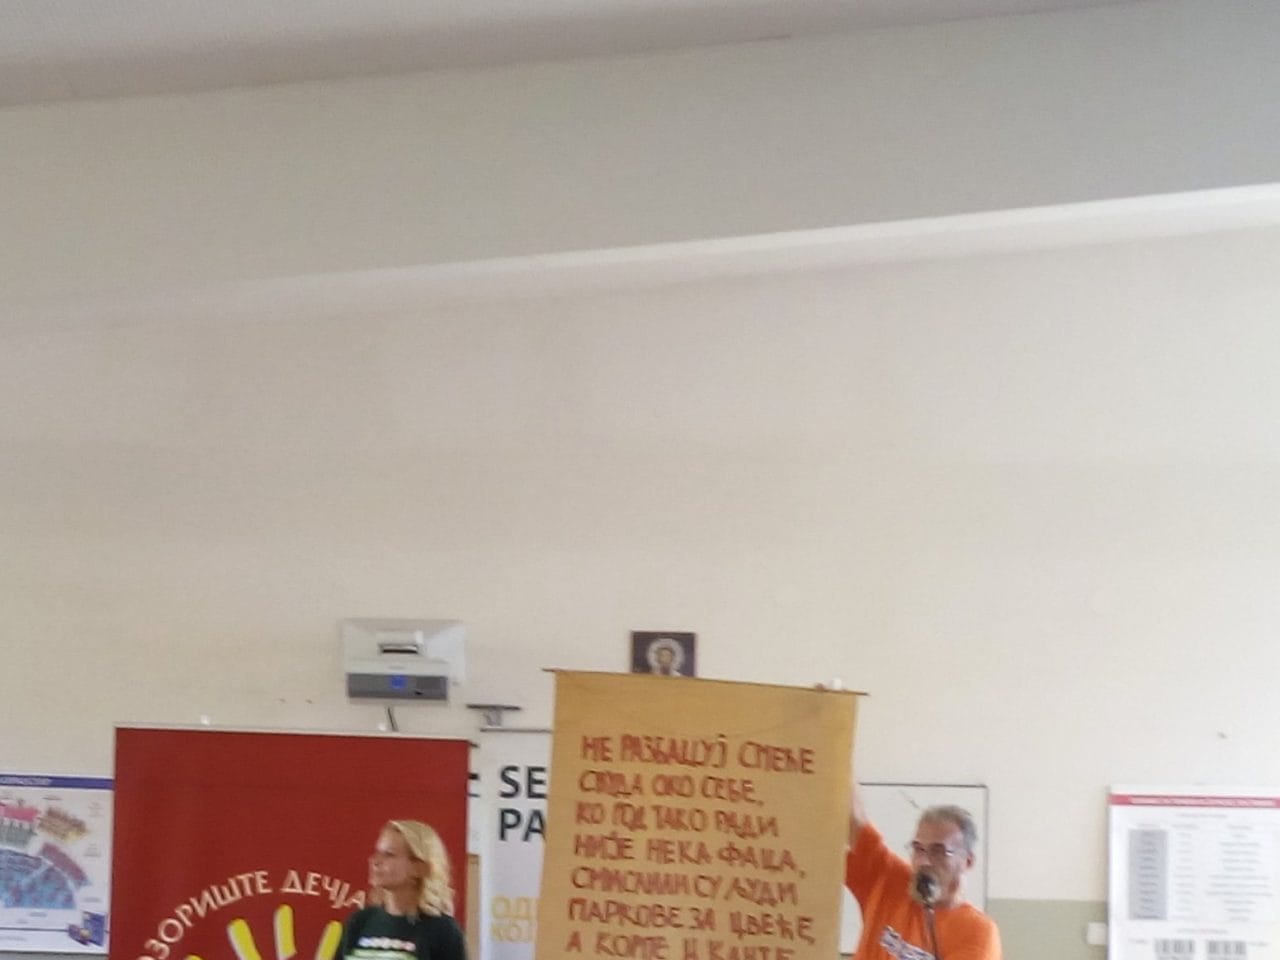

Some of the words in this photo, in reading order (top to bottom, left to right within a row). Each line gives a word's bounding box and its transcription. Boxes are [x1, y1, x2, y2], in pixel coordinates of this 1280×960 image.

[581, 735, 613, 763] НЕ
[498, 765, 548, 800] SE
[652, 774, 695, 798] ОКО
[497, 807, 547, 842] PA
[575, 802, 606, 825] КО
[612, 802, 648, 832] ГОД
[652, 804, 709, 833] ТАКО
[714, 810, 780, 839] РАДИ
[573, 831, 636, 860] НИЈЕ
[646, 837, 713, 865] НЕКА
[693, 874, 722, 900] СУ
[568, 897, 684, 929] ПАРКОВЕ
[688, 907, 716, 931] ЗА
[565, 930, 582, 953] А
